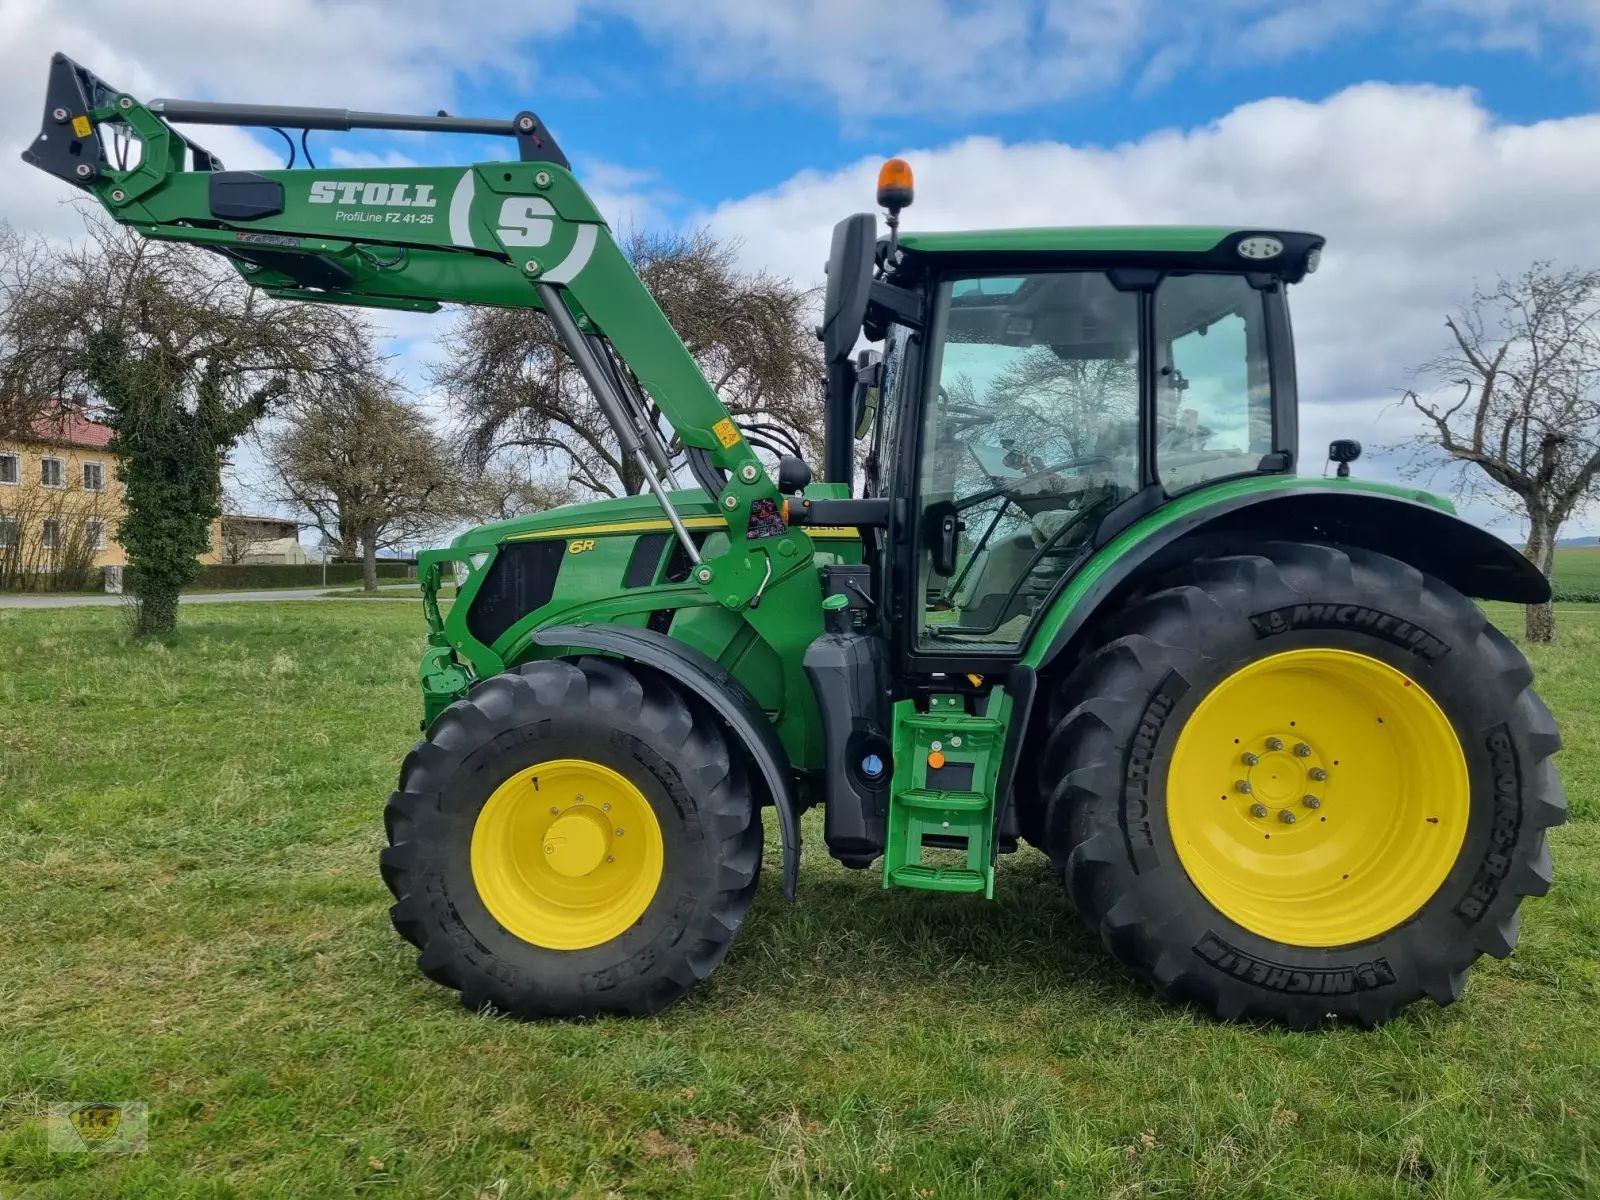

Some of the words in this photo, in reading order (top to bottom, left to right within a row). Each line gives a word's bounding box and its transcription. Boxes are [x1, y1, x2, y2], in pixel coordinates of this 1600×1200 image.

[308, 181, 437, 207] STOLL
[335, 211, 382, 222] ProfiLine
[385, 213, 401, 223] FZ
[403, 213, 434, 224] 41-25
[496, 196, 556, 247] S
[568, 540, 595, 554] 6R
[1293, 605, 1450, 660] MICHELIN
[1194, 937, 1353, 994] MICHELIN
